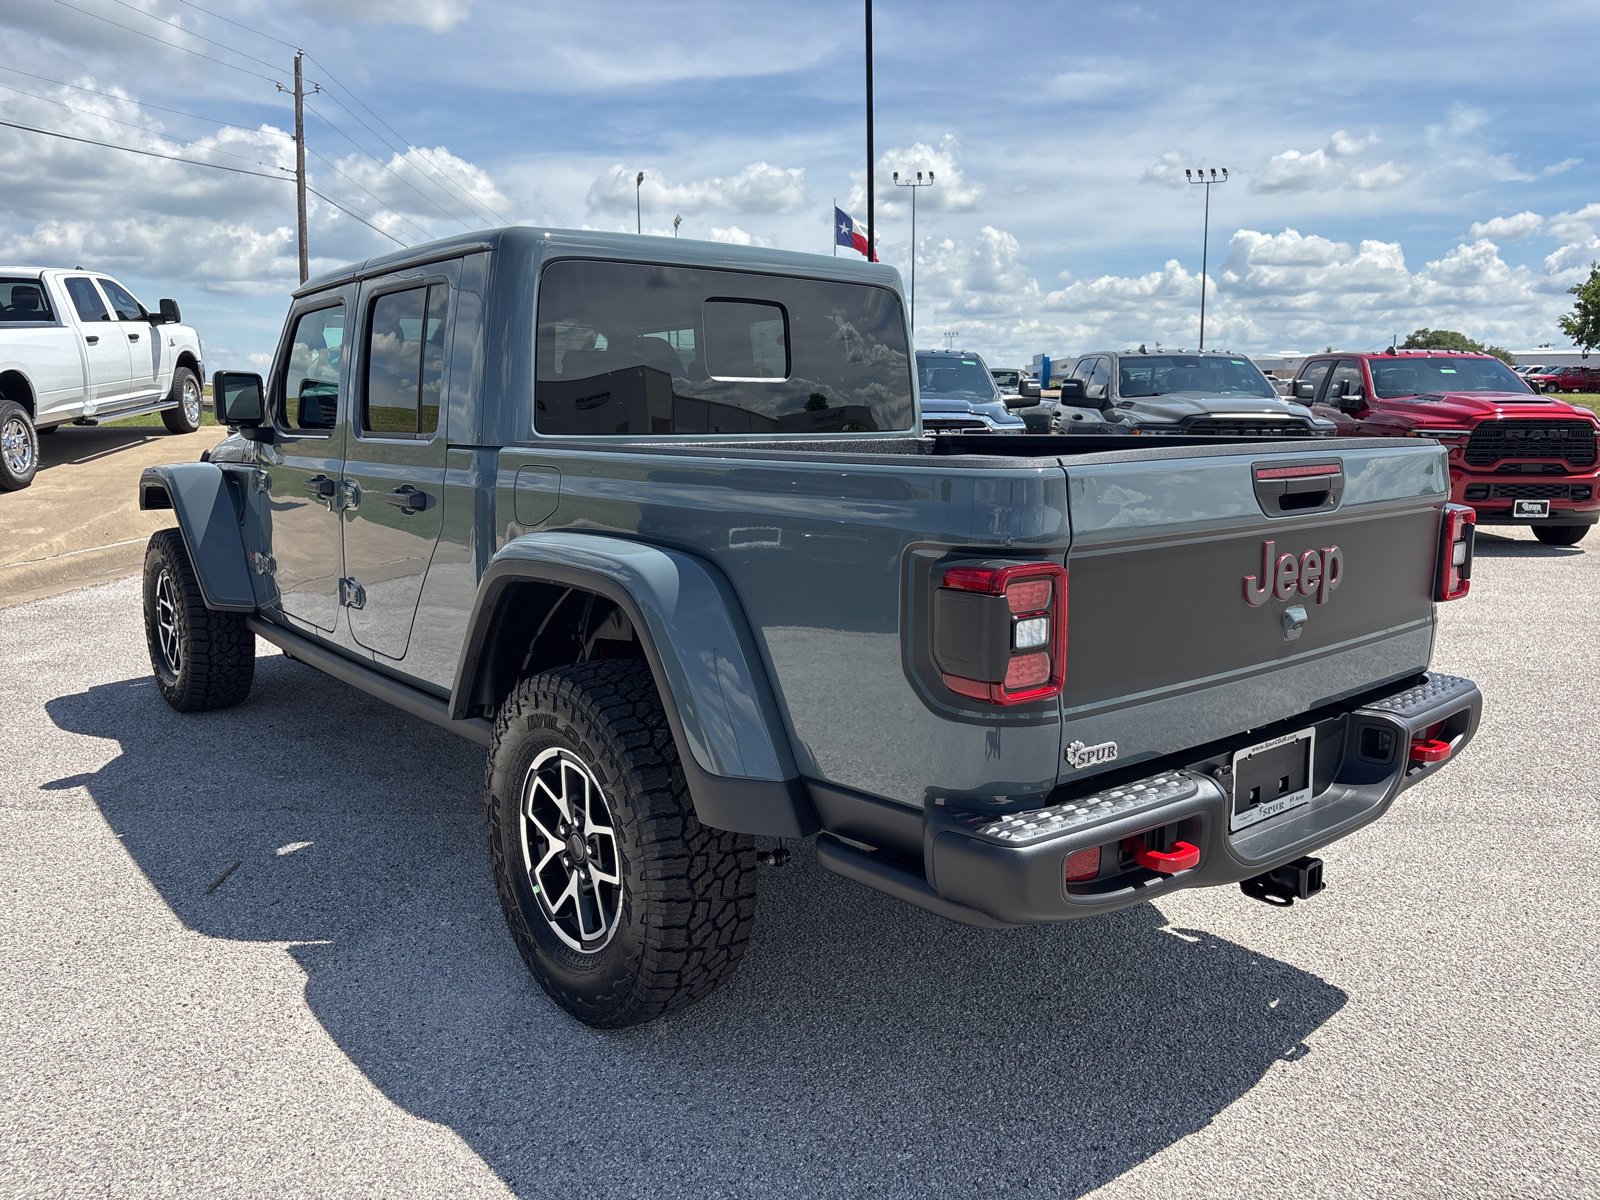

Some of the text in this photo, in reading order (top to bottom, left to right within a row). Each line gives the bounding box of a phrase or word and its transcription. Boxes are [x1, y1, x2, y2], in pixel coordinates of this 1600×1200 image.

[1505, 429, 1569, 439] RAM
[1243, 540, 1344, 608] Jeep
[1077, 745, 1116, 766] SPUR
[1262, 801, 1285, 817] SPUR
